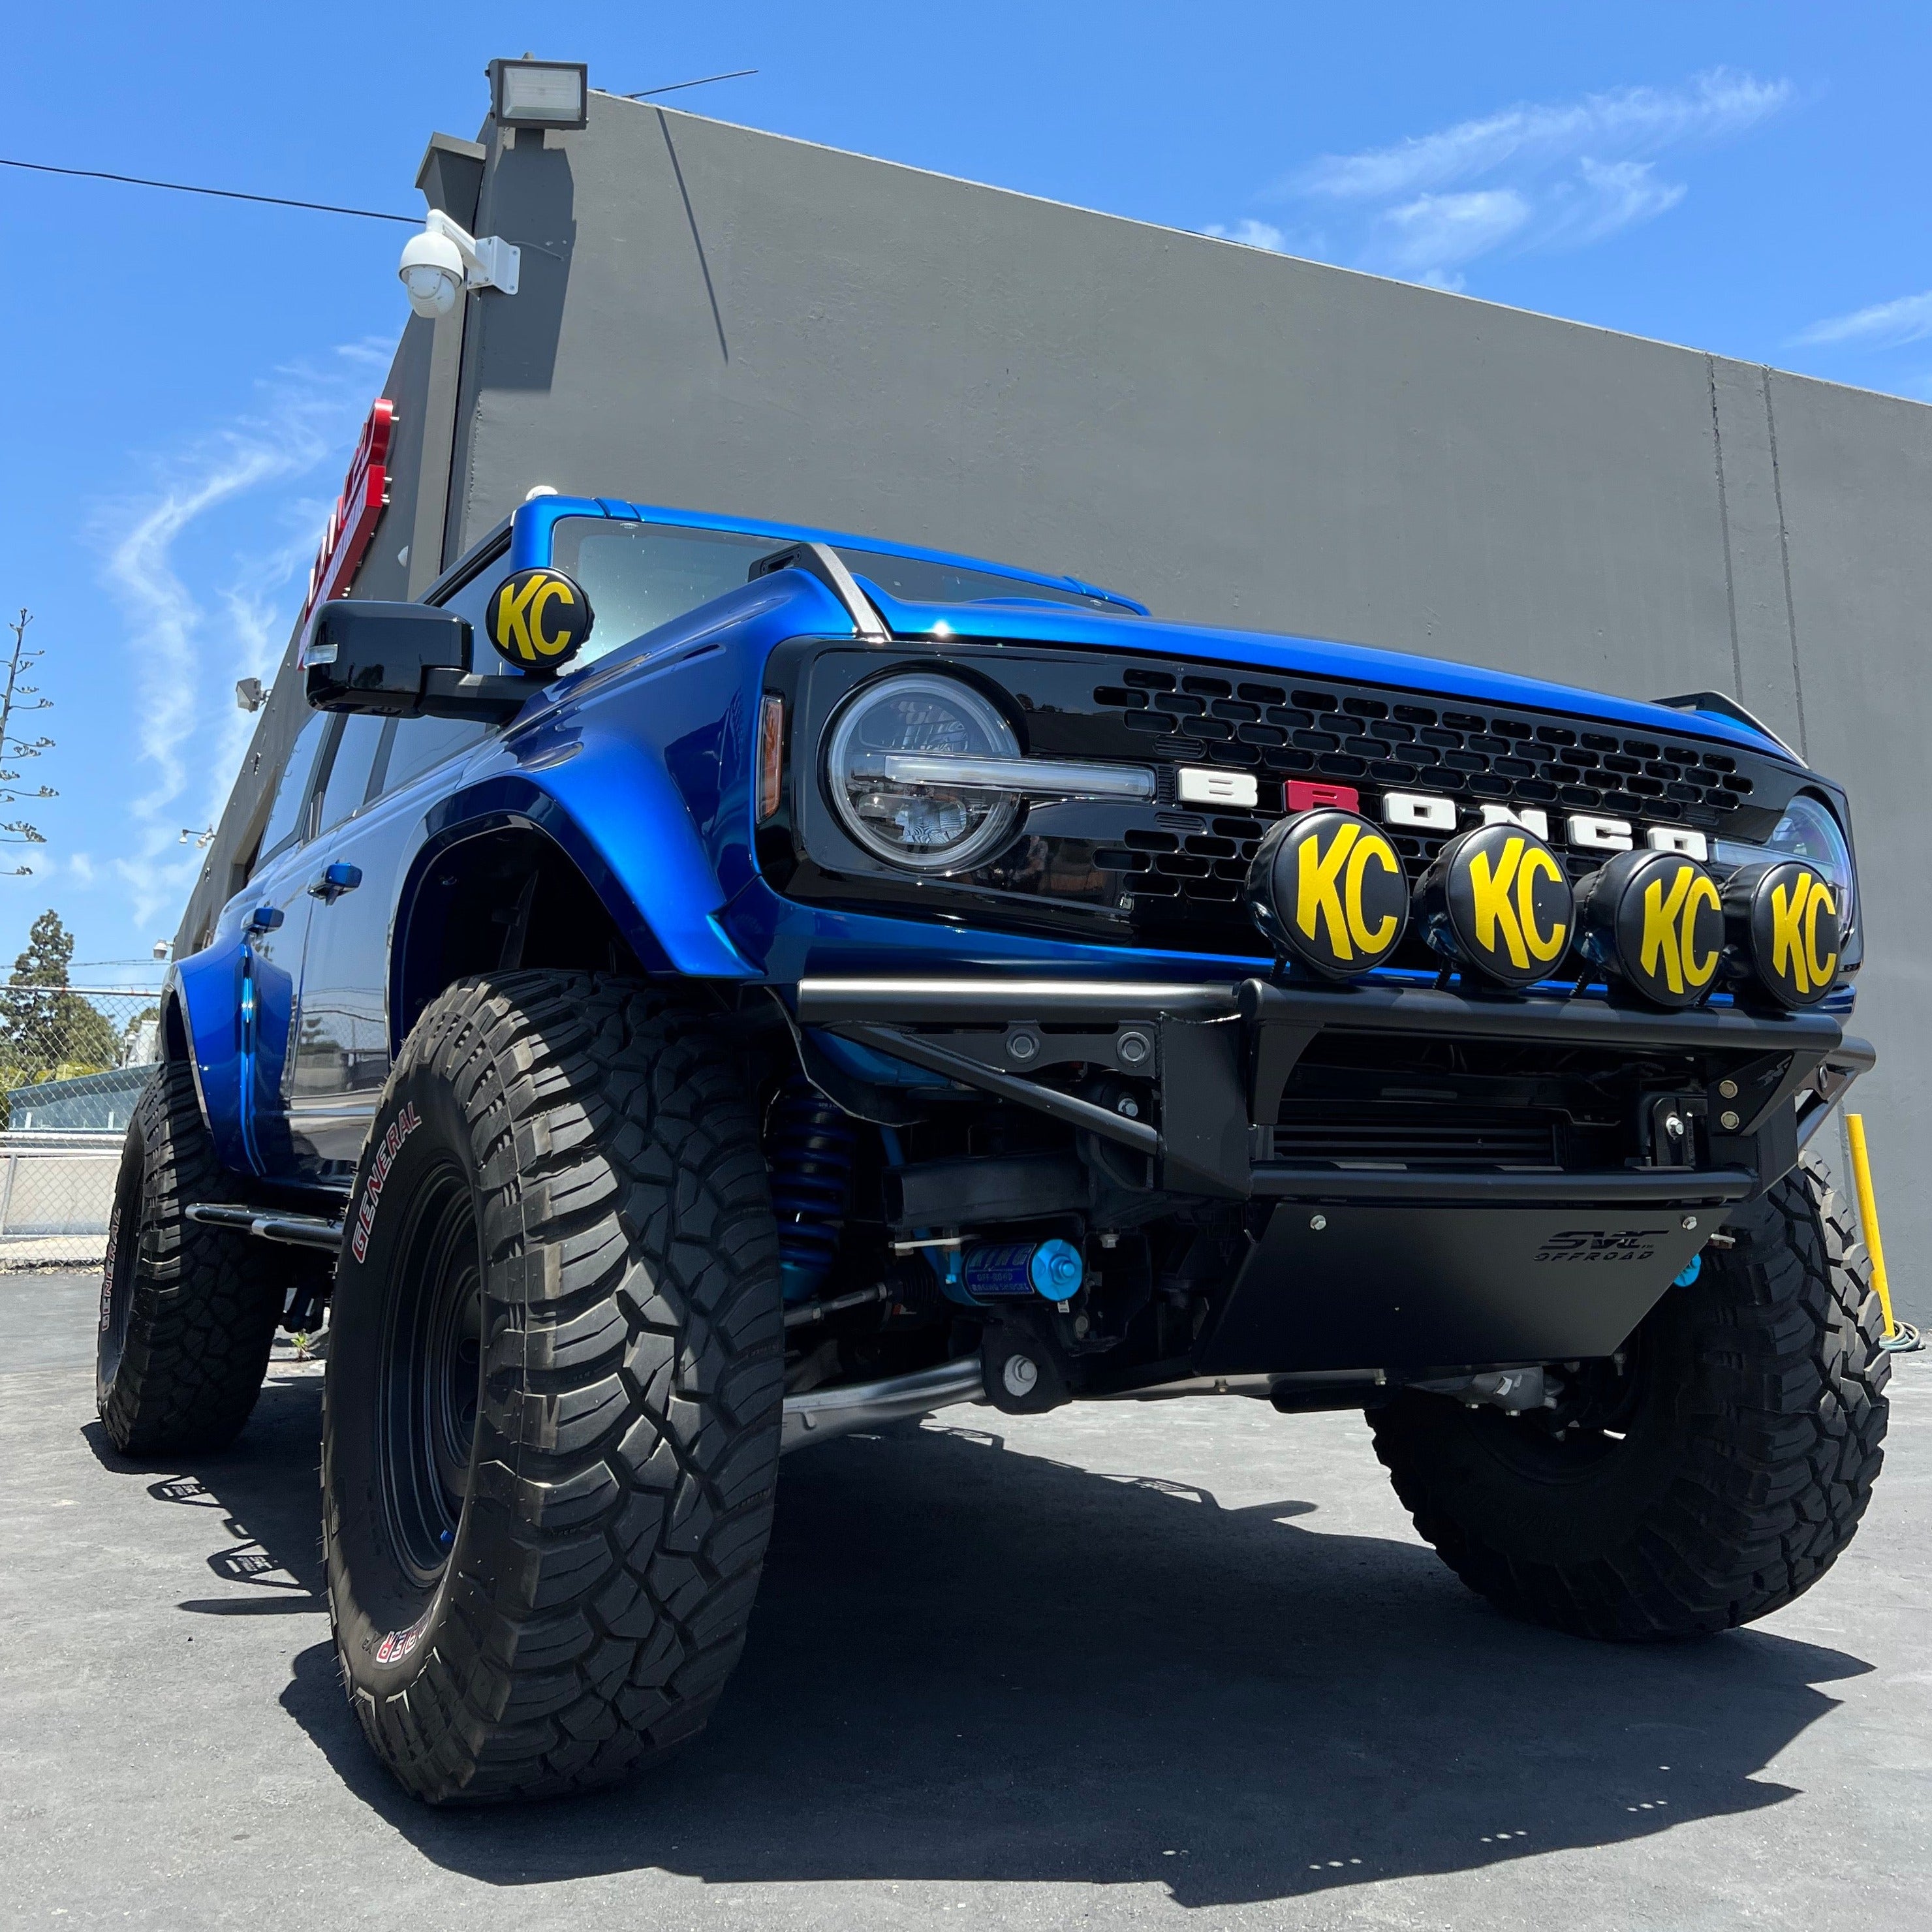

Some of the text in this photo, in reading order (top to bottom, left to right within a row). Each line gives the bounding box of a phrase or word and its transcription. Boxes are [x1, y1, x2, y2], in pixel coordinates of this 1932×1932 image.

[497, 574, 574, 661] KC
[1177, 768, 1709, 862] BRONCO
[1296, 823, 1398, 961] KC
[1470, 837, 1566, 969] KC
[1640, 866, 1721, 995] KC
[1771, 872, 1837, 994] KC
[351, 1100, 422, 1264] GENERAL
[101, 1208, 122, 1332] GENERAL
[1533, 1251, 1655, 1262] OFFROAD
